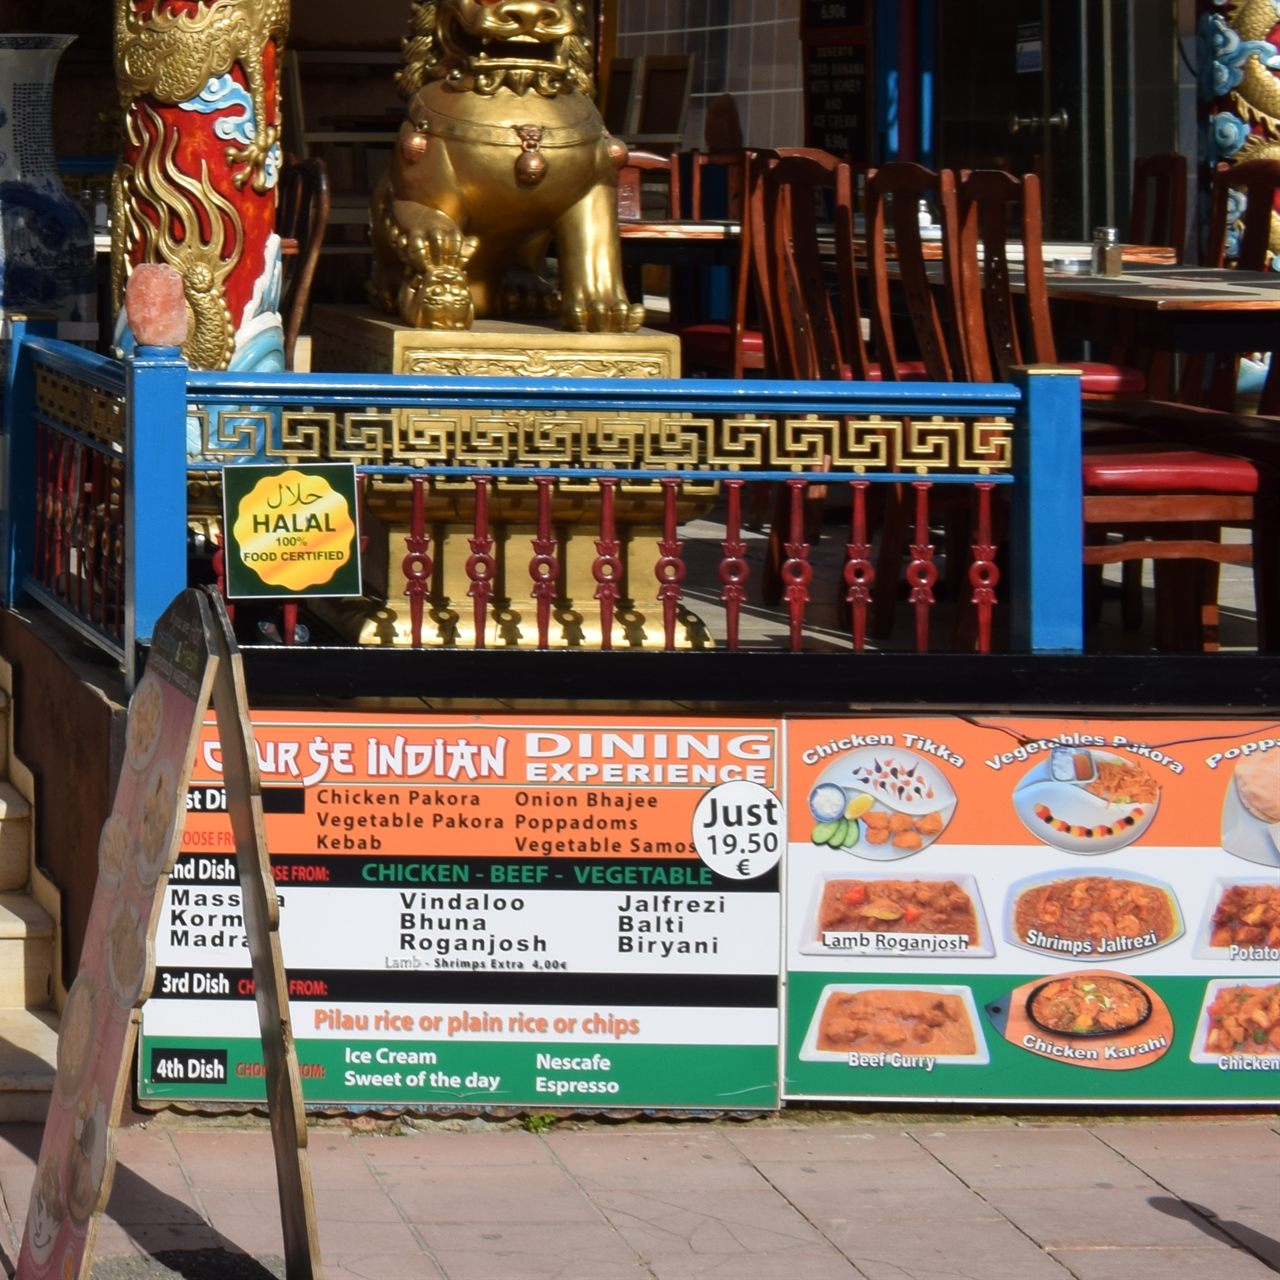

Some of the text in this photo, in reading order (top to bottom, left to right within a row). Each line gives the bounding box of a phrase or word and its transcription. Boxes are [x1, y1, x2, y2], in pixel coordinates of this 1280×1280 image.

[267, 483, 323, 509] حلال
[253, 513, 336, 533] HALAL
[276, 536, 308, 547] 100%
[244, 551, 344, 562] FOOD CERTIFIED
[203, 733, 770, 788] CURSE INDIAN DINING
[801, 733, 1280, 775] Chicken Tikka Vegetables Pakora Popp
[526, 763, 766, 785] EXPERIENCE
[317, 789, 657, 811] Chicken Pakora Onion Bhajee
[516, 815, 637, 833] Poppadoms
[703, 797, 778, 829] Just
[317, 834, 381, 850] Kebab
[708, 832, 778, 855] 19.50
[361, 864, 713, 885] CHICKEN VEGETABLE
[400, 893, 724, 912] Vindaloo Jalfrezi
[171, 910, 683, 932] Korm Bhuna Balti
[401, 934, 717, 957] Roganjosh Biryani
[822, 930, 1280, 961] Lamb Roganjosh Shrimps Jalfrezi Potato
[434, 958, 524, 971] Shrimps Extra
[314, 1009, 640, 1039] Pilau plain chips
[537, 1054, 610, 1070] Nescafe
[848, 1035, 1279, 1070] Beef Curry Chicken Karahi Chicken
[345, 1071, 401, 1086] Sweet
[536, 1077, 619, 1095] Espresso
